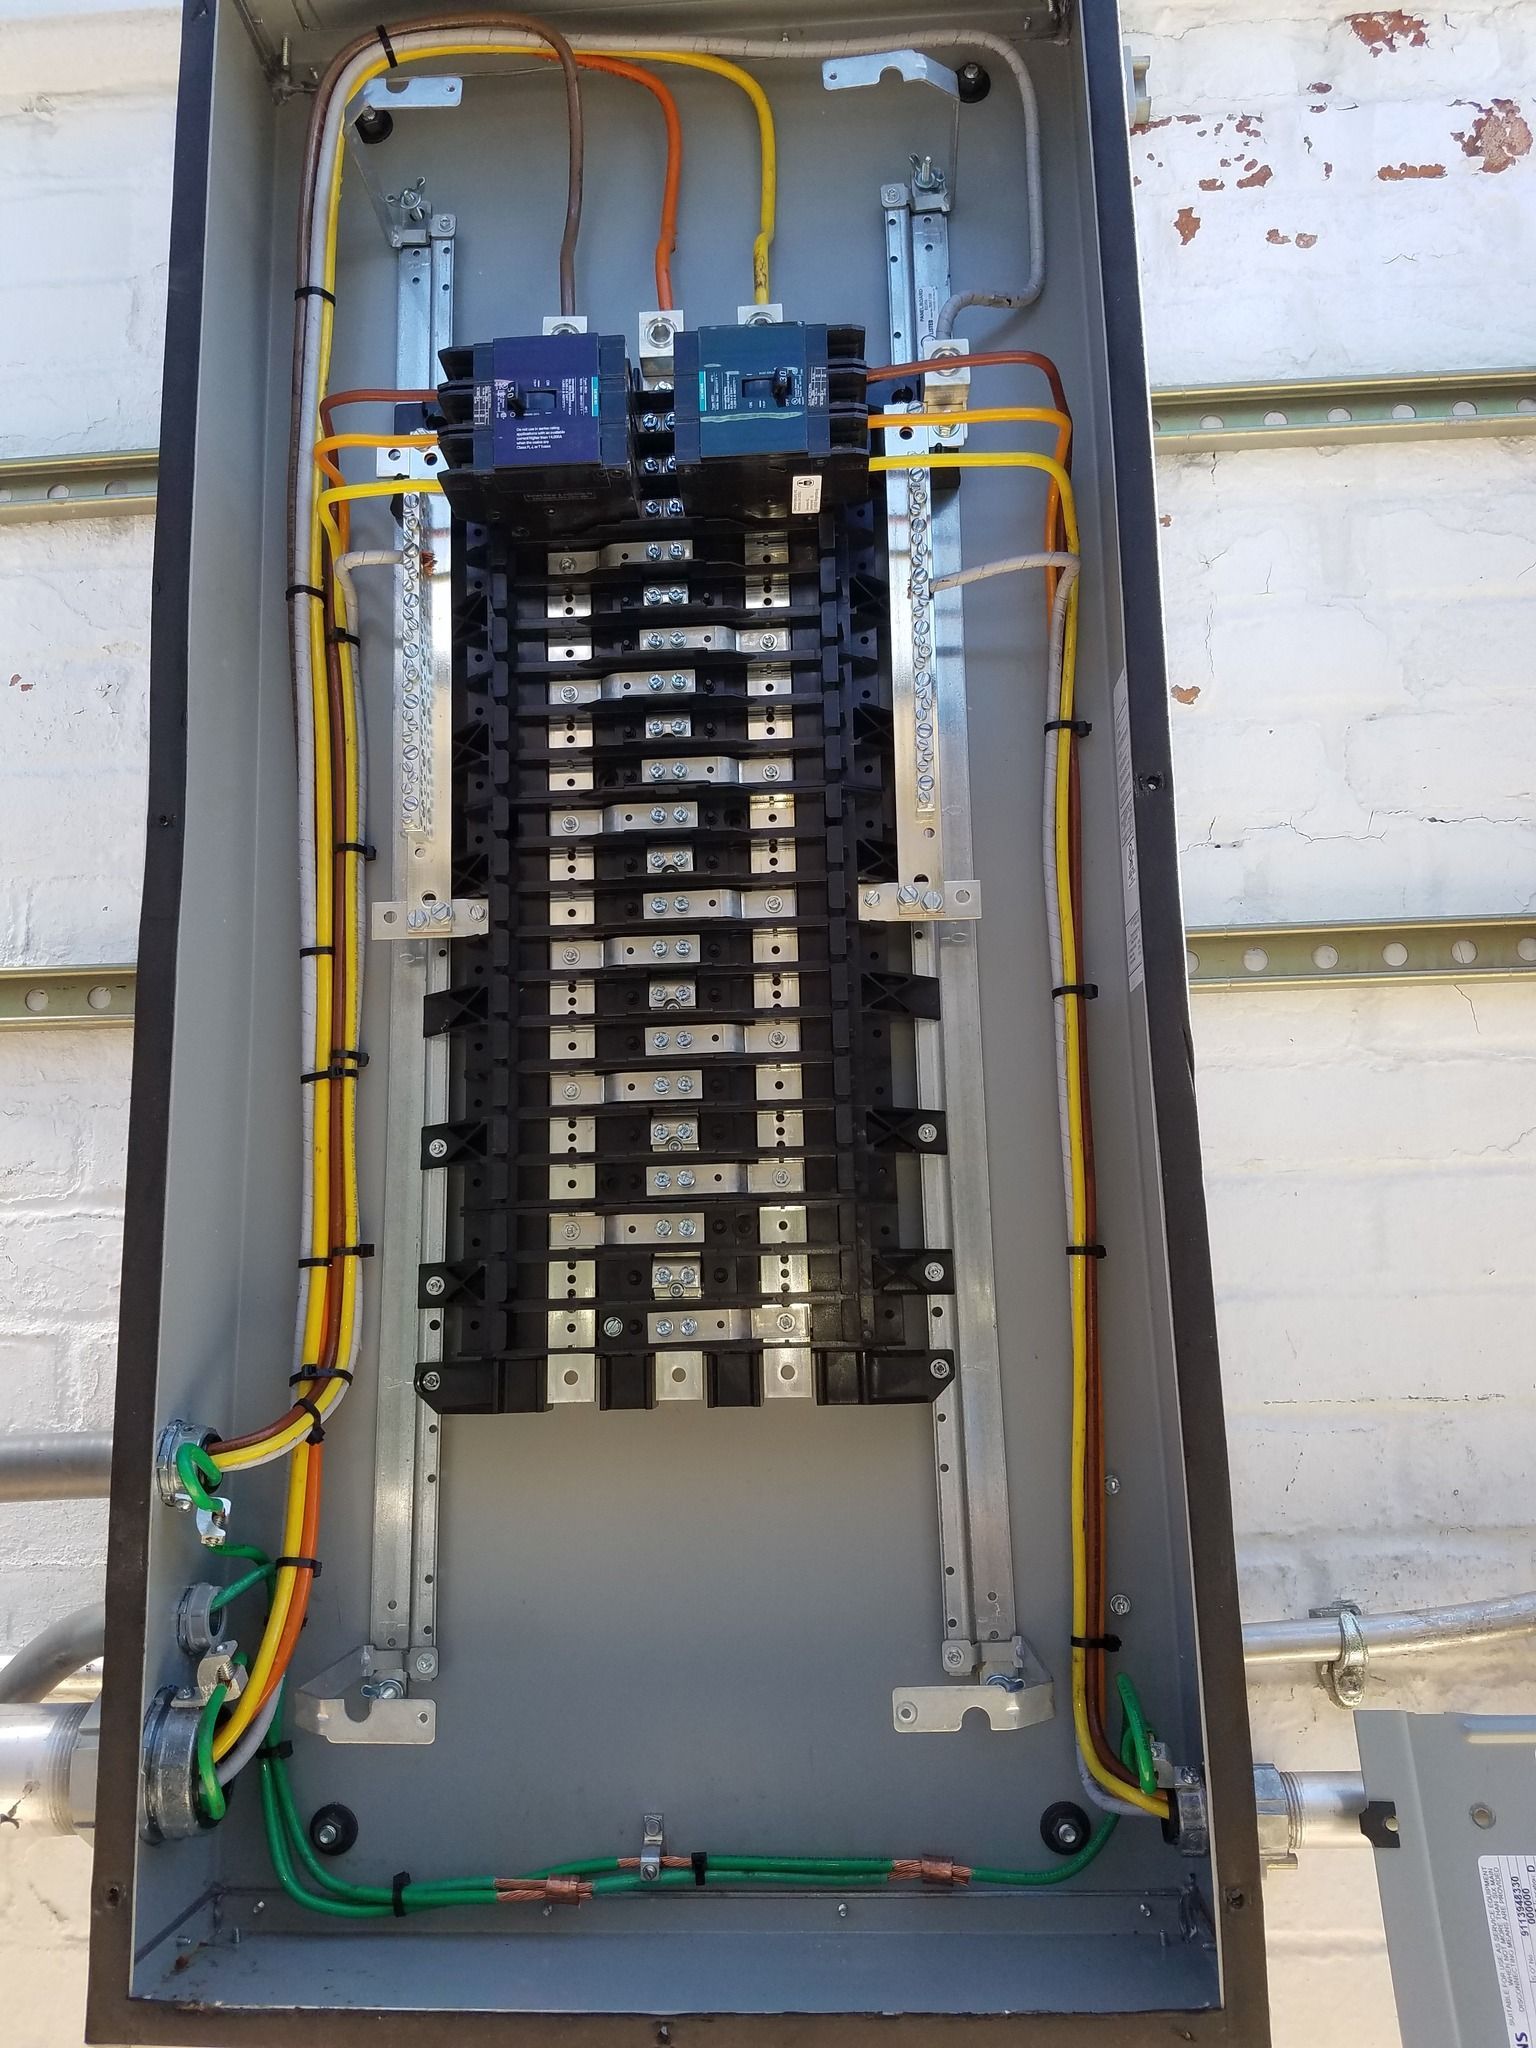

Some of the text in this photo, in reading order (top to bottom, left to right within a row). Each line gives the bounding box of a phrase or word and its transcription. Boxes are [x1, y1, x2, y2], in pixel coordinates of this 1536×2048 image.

[507, 386, 515, 399] 50
[779, 371, 788, 383] 30
[1526, 1865, 1536, 1873] D
[1487, 1867, 1514, 1986] WHEN NOT MORE THAN SIX MAIN
[1511, 1876, 1529, 1937] 9113948330
[1521, 1888, 1536, 1925] 000000
[1481, 1866, 1515, 2026] SUITABLE FOR USE AS SERVICE EQUIPMENT
[1493, 1866, 1525, 2013] DISCONNECTING MEANS ARE PROVIDED
